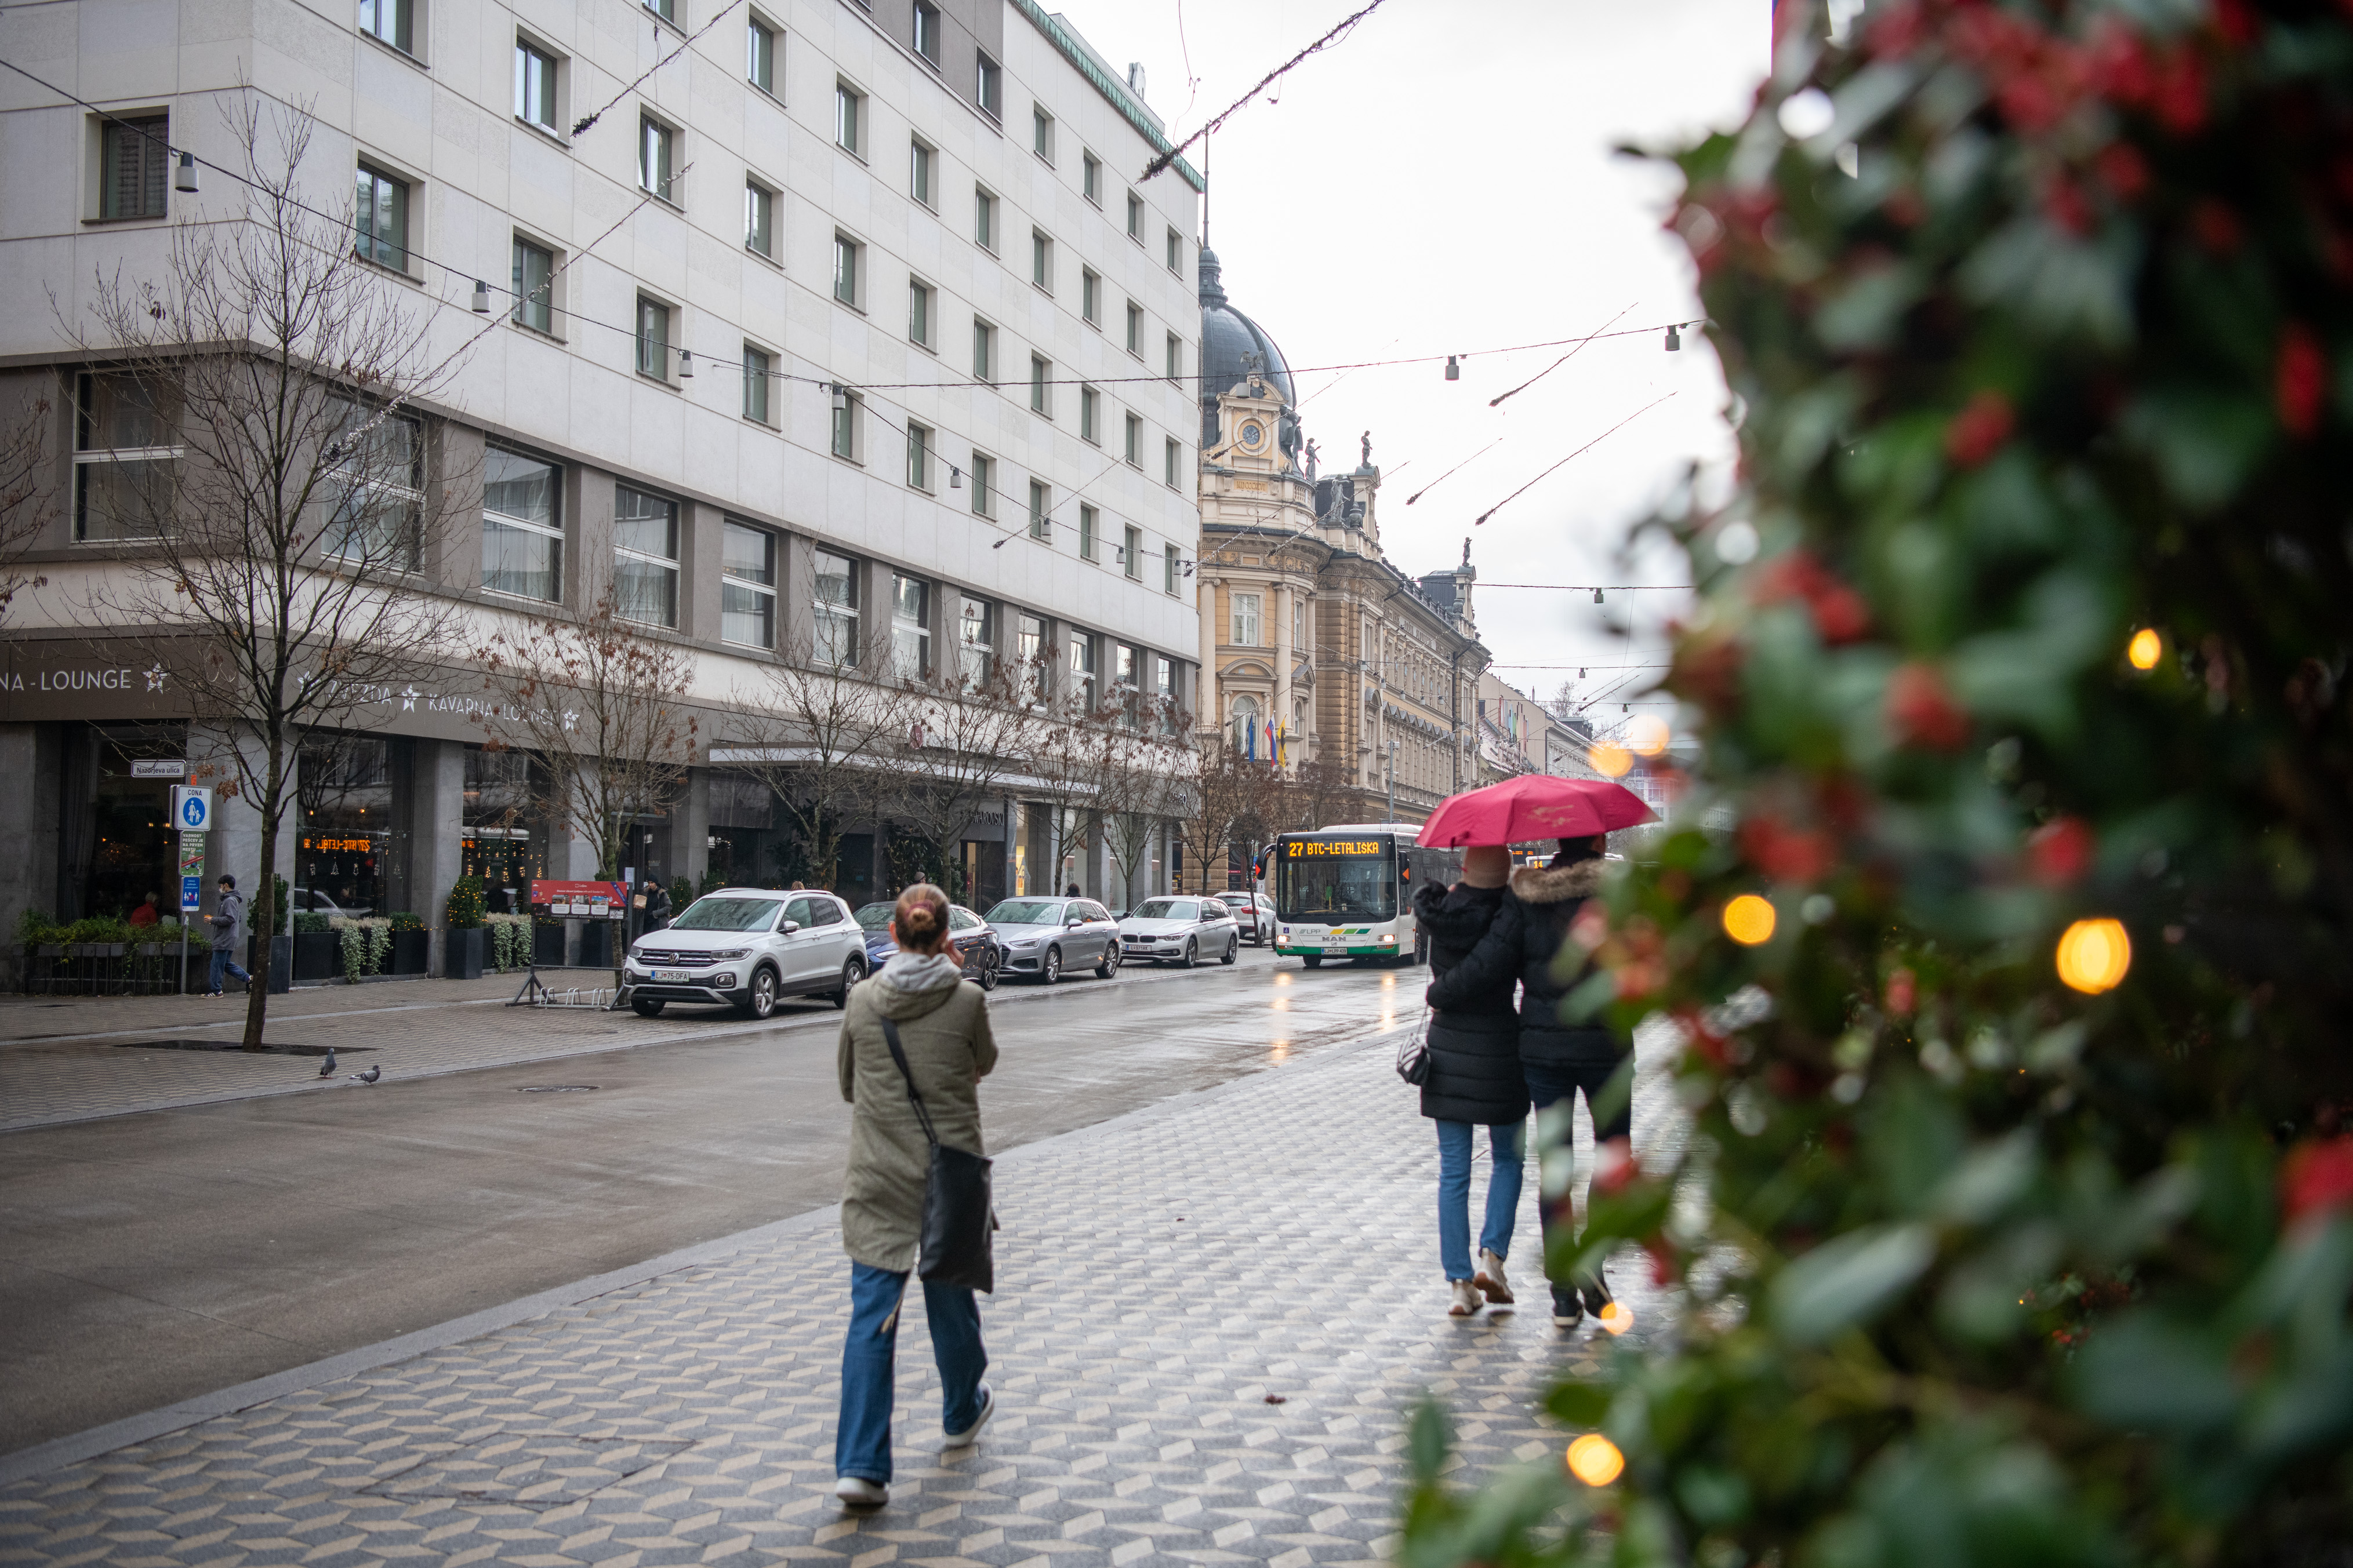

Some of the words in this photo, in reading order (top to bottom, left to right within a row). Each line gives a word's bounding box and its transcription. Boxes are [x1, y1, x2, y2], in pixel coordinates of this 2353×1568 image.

[41, 670, 131, 690] LOUNGE
[429, 693, 493, 717] KAVARNA
[1289, 842, 1303, 857] 27
[1307, 842, 1379, 855] BTC-LETALIŠKA
[1534, 860, 1543, 869] 14
